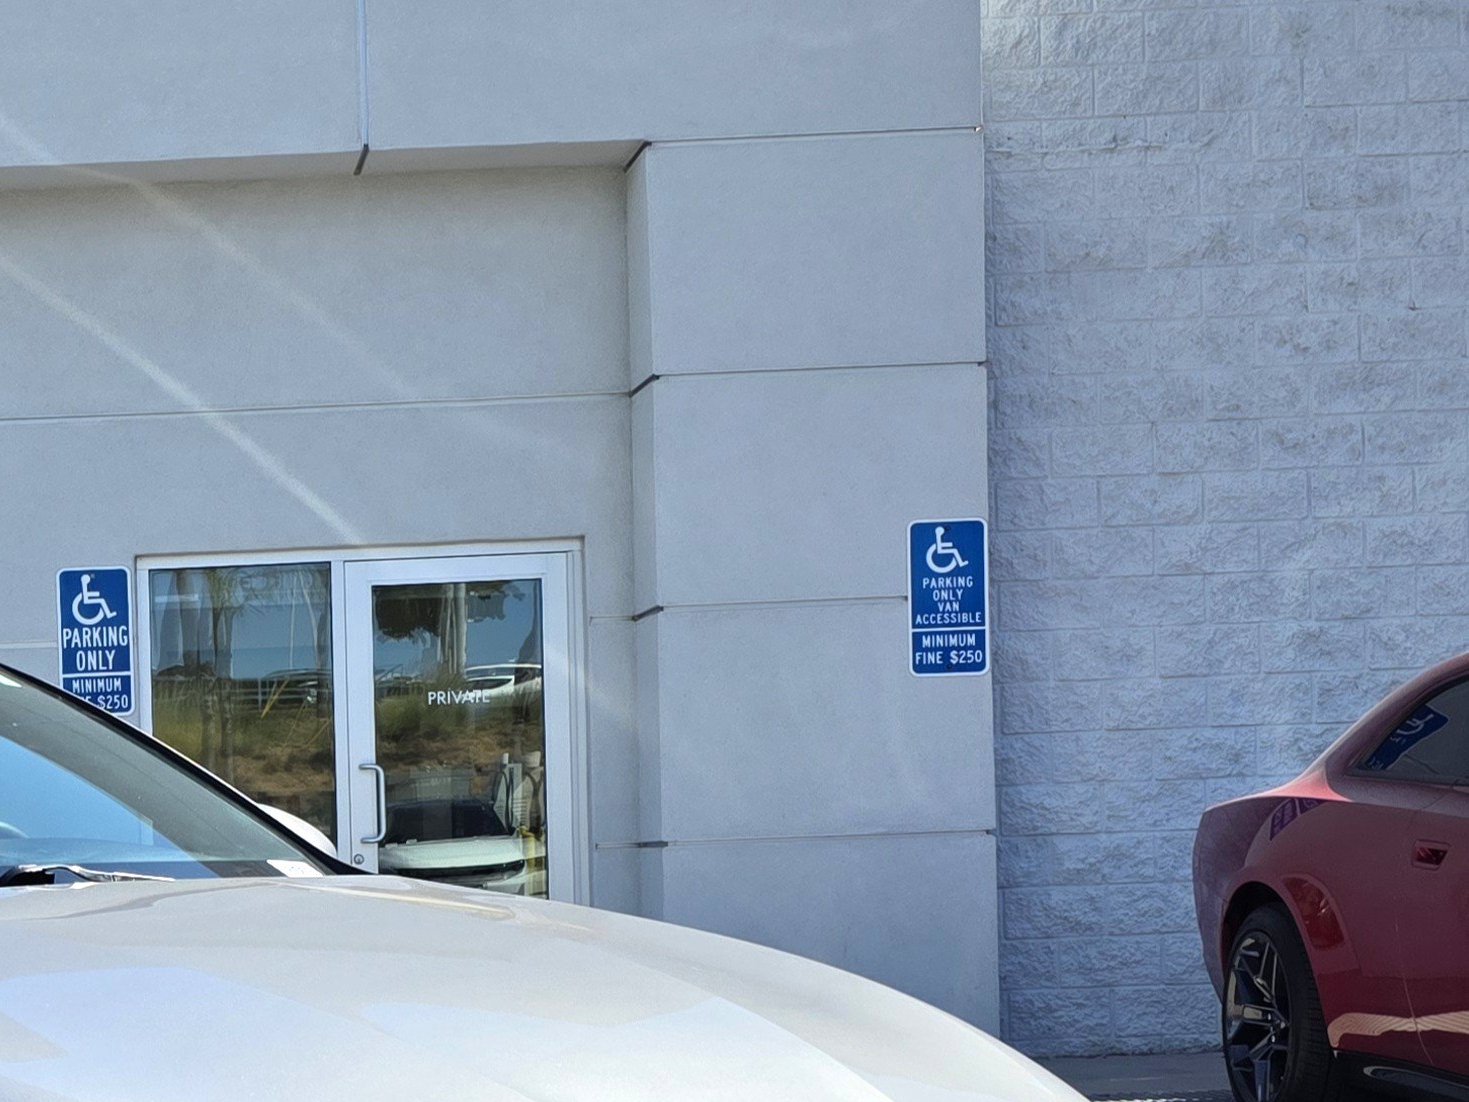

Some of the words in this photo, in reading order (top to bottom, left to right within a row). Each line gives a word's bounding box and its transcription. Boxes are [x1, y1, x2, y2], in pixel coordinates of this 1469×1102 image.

[922, 576, 974, 589] PARKING
[932, 589, 964, 601] ONLY
[937, 601, 960, 612] VAN
[915, 612, 982, 625] ACCESSIBLE
[62, 625, 128, 649] PARKING
[922, 633, 976, 648] MINIMUM
[76, 649, 116, 671] ONLY
[915, 651, 944, 665] FINE
[949, 649, 983, 665] $250
[72, 677, 122, 694] MINIMUM
[97, 694, 129, 710] $250
[427, 689, 491, 705] PRIVATE
